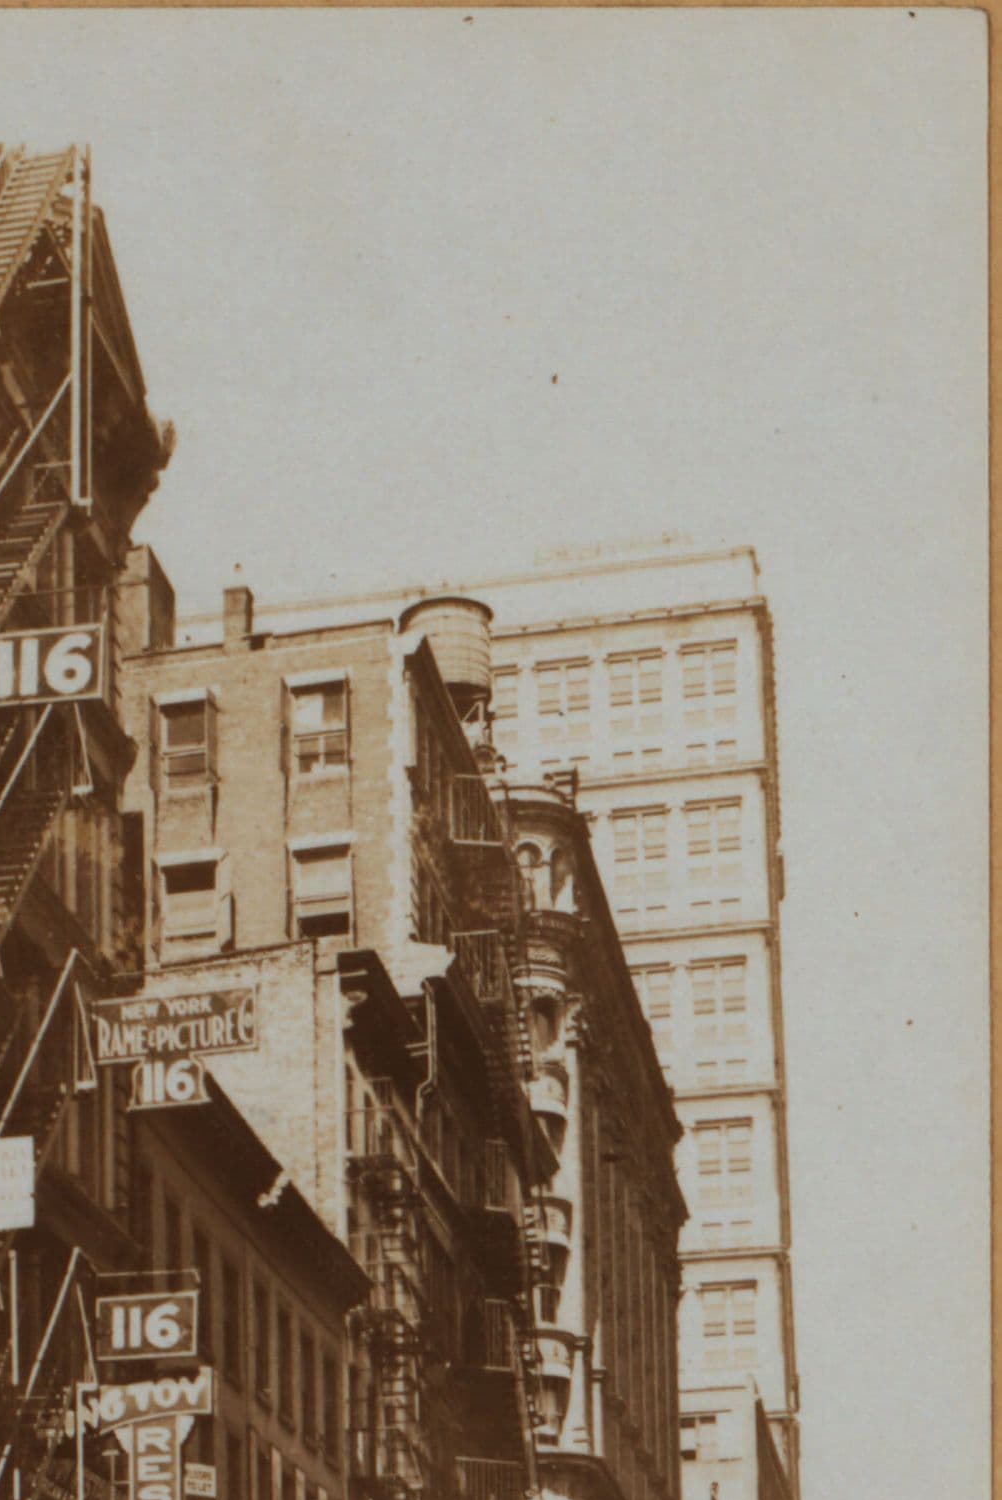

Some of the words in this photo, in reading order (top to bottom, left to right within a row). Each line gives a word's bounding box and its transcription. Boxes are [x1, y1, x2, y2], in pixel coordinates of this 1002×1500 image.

[121, 1002, 159, 1021] NEW
[164, 996, 212, 1016] YORK
[94, 1016, 149, 1059] RAME
[156, 1008, 238, 1052] PICTURE
[142, 1059, 195, 1103] 116
[110, 1302, 181, 1350] 116
[127, 1376, 204, 1412] TOY
